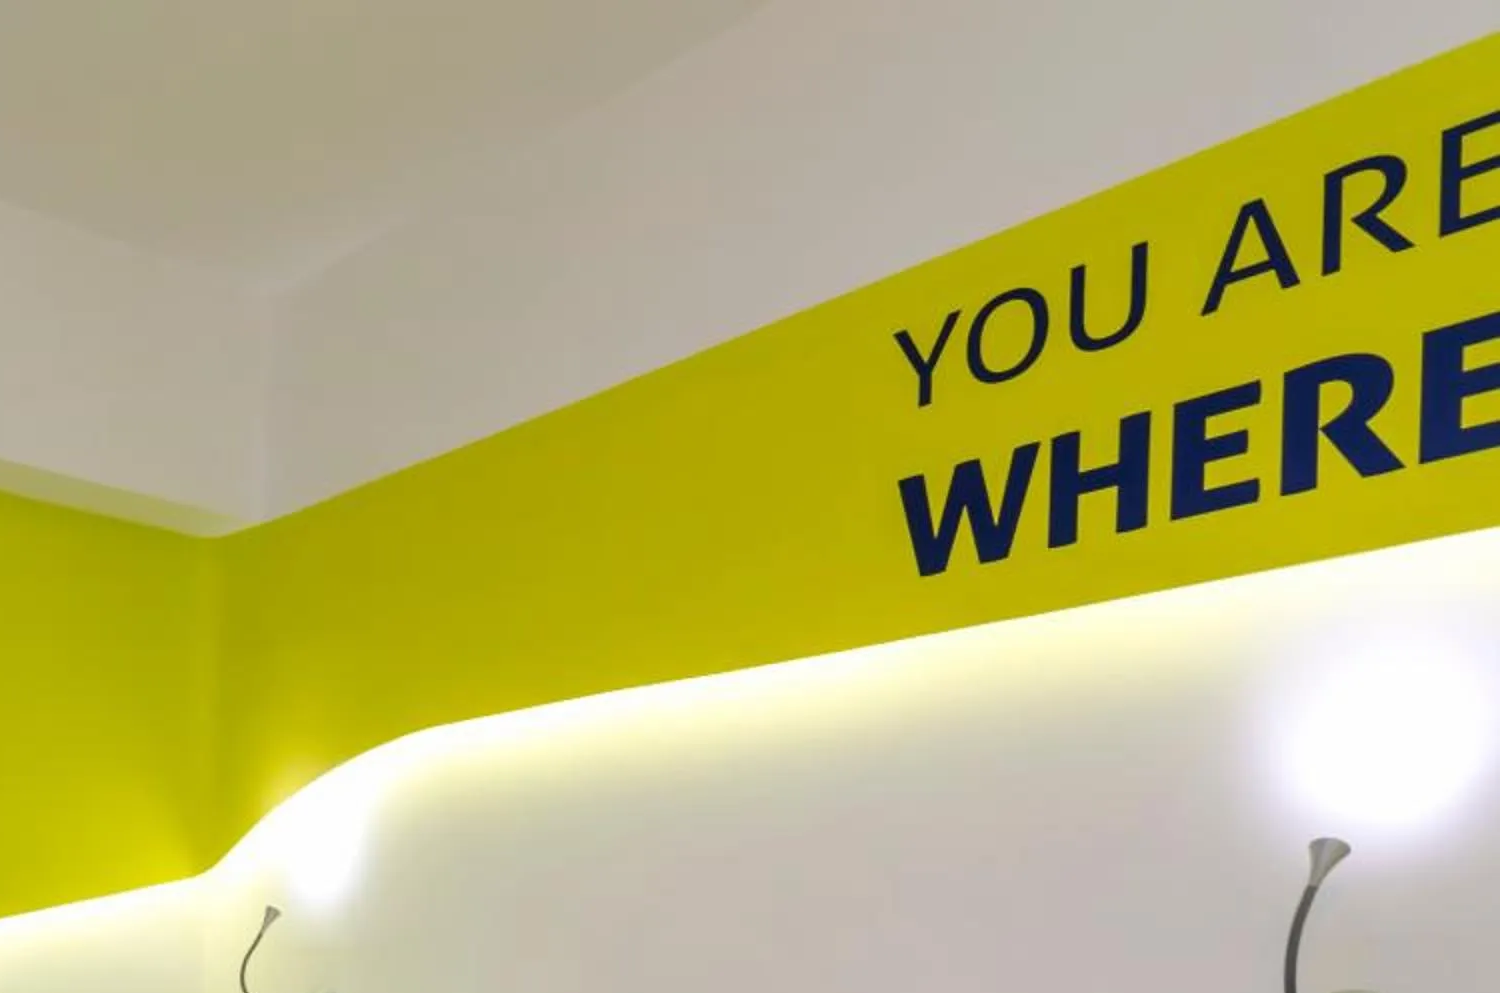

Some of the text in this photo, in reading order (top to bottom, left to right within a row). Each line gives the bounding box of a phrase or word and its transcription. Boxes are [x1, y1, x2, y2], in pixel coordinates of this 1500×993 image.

[893, 110, 1500, 407] YOU ARE
[898, 311, 1500, 577] WHERE
